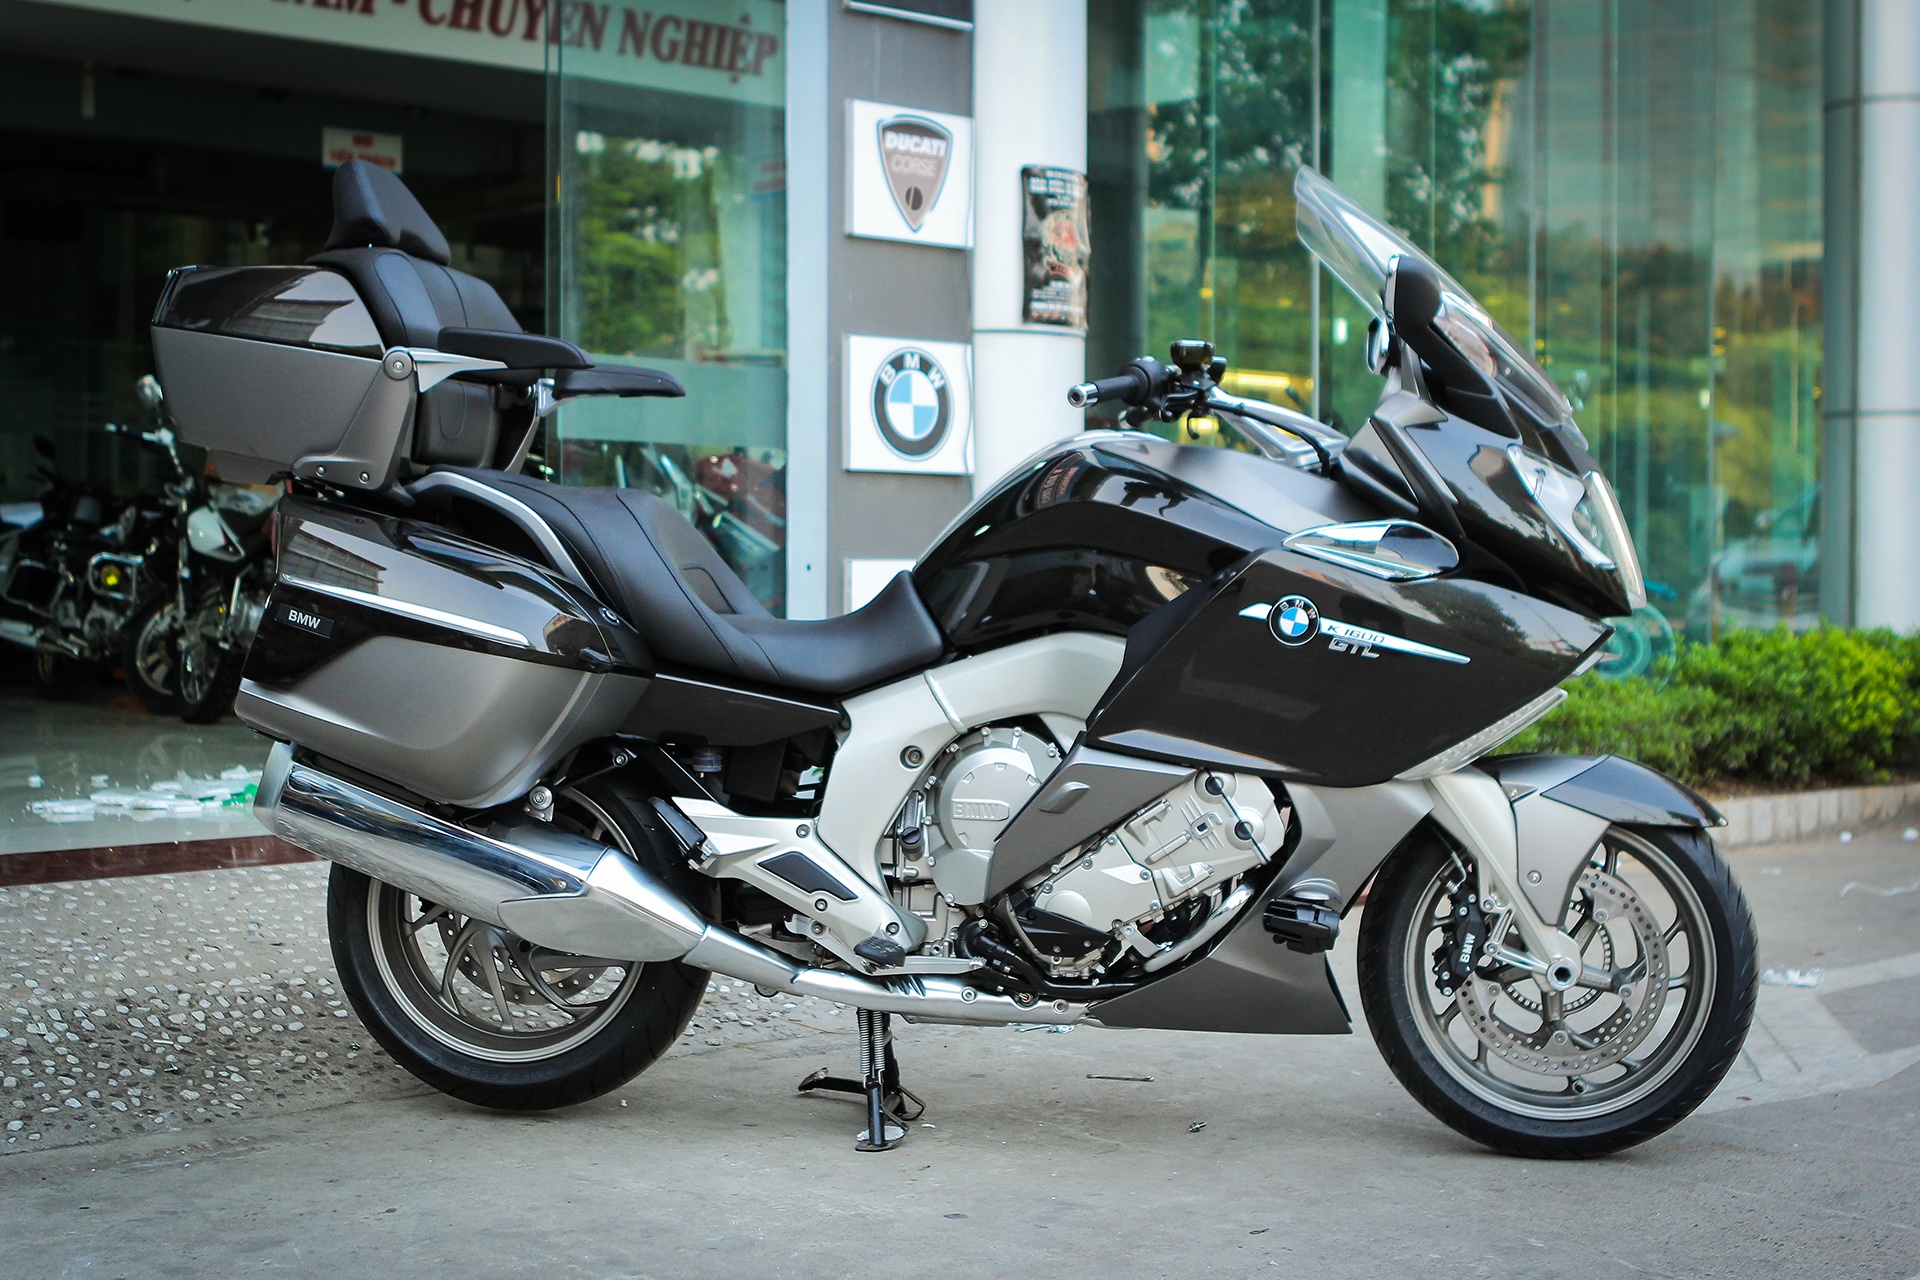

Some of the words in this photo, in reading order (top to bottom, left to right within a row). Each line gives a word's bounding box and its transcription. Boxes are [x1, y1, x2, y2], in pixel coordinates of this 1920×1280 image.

[884, 131, 947, 156] DUCATI
[891, 156, 938, 177] CORSE
[881, 353, 946, 389] BMW
[289, 609, 321, 629] BMW
[1279, 599, 1317, 619] BMW
[1327, 625, 1339, 634] K
[1344, 628, 1385, 644] 1600
[1328, 636, 1380, 659] GTL
[953, 803, 999, 819] BMW
[1460, 932, 1476, 964] BMW
